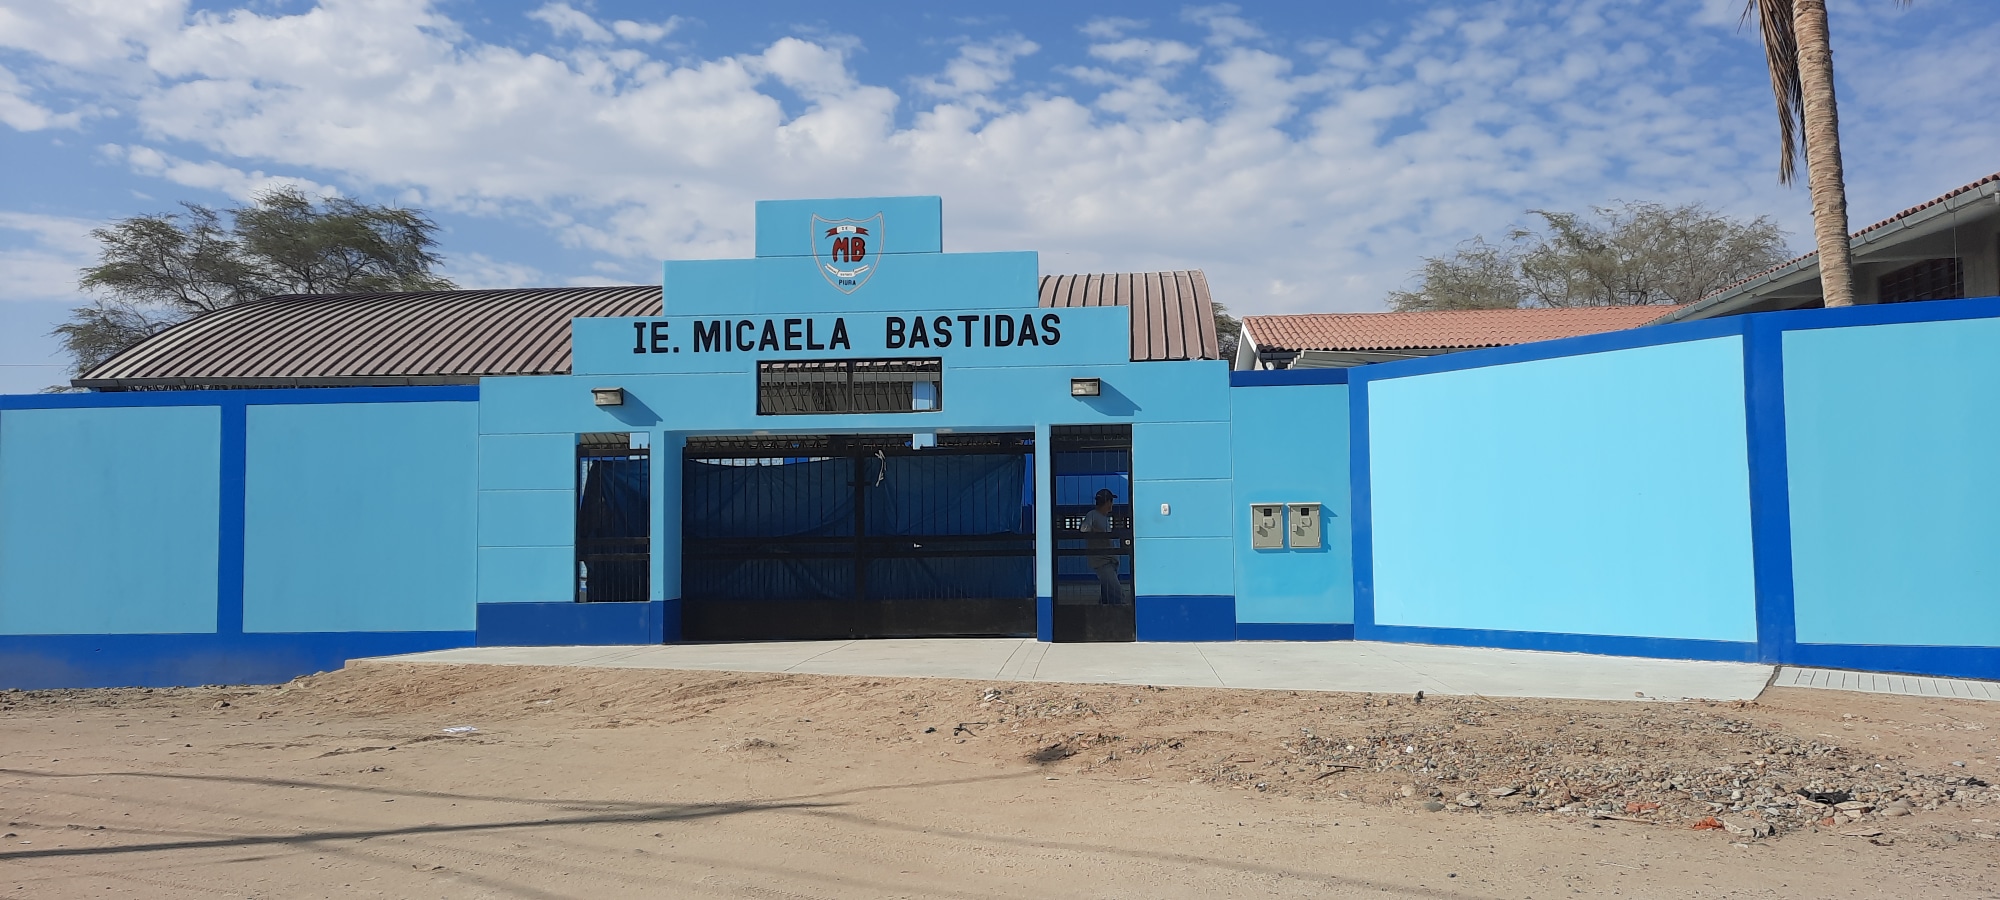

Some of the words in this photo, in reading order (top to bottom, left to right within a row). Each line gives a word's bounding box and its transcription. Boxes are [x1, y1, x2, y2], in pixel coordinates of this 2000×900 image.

[832, 237, 866, 262] MB
[633, 321, 680, 354] IE.
[692, 317, 851, 353] MICAELA
[885, 313, 1061, 349] BASTIDAS
